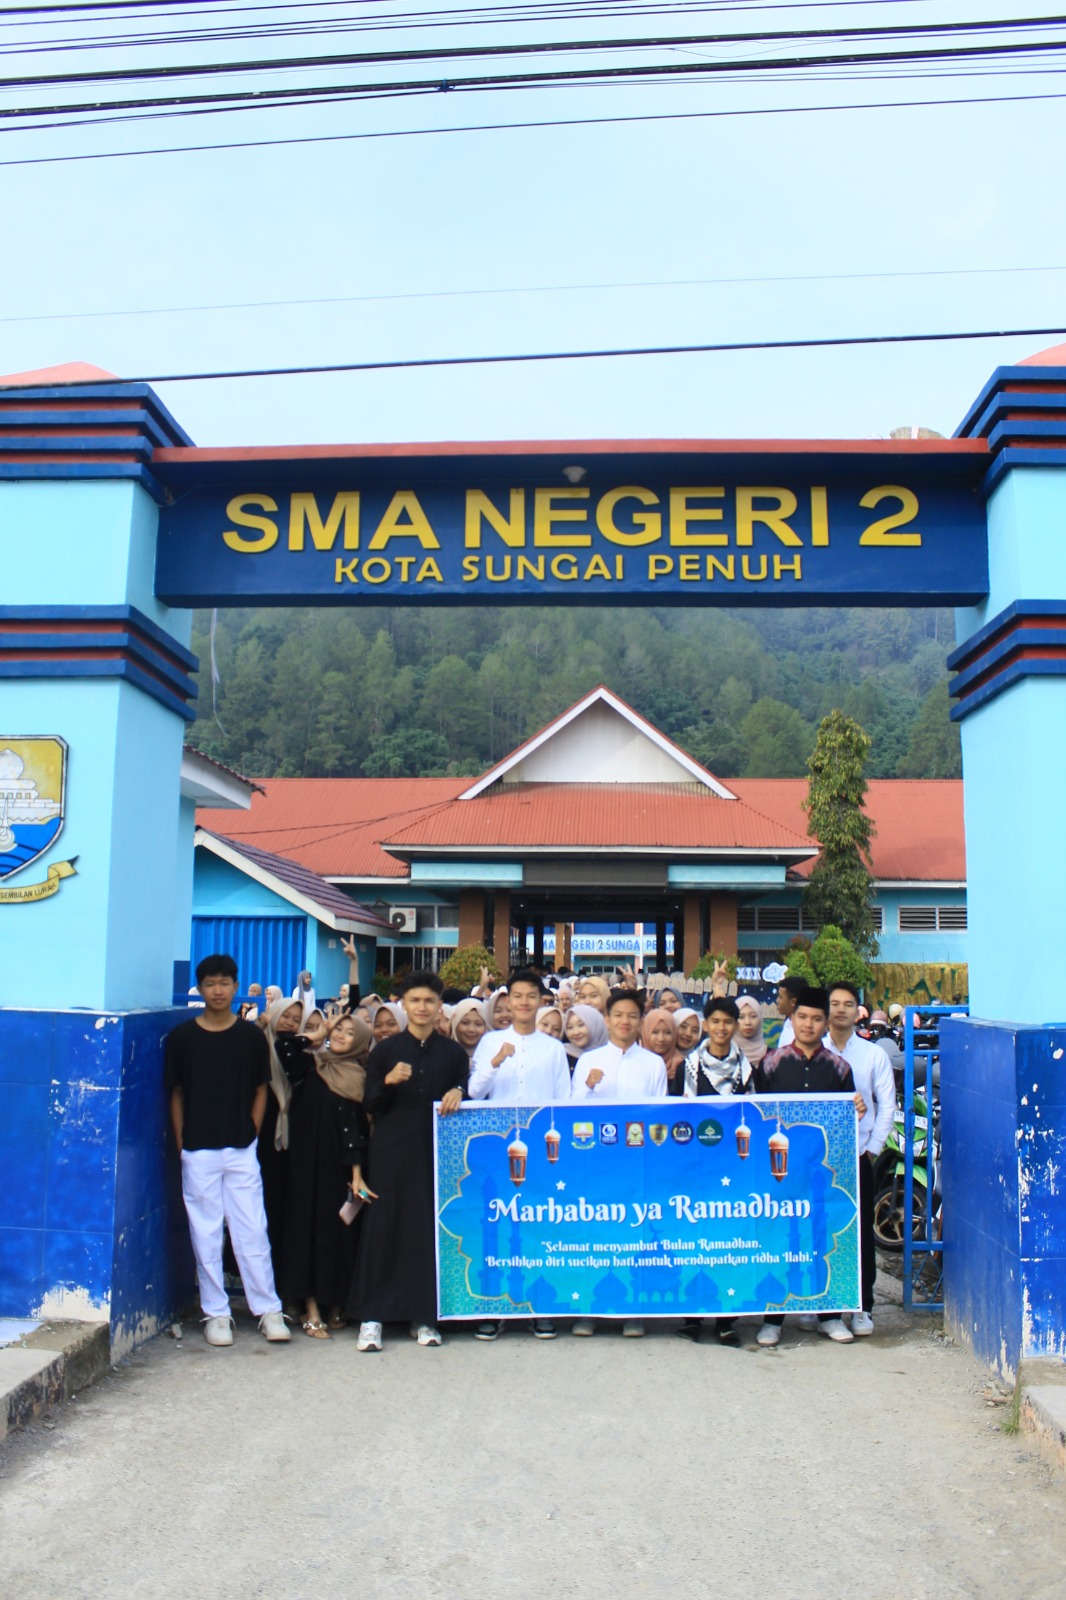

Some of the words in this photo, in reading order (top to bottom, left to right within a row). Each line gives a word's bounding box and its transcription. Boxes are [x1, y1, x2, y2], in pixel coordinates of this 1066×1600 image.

[222, 490, 441, 553] SMA
[464, 485, 829, 548] NEGERI
[858, 484, 922, 546] 2
[334, 557, 443, 583] KOTA
[462, 554, 624, 581] SUNGAI
[648, 554, 802, 580] PENUH
[572, 940, 595, 950] GERI
[598, 940, 604, 950] 2
[606, 940, 641, 950] SUNGA
[487, 1193, 627, 1224] Marhaban
[630, 1202, 663, 1227] ya
[668, 1193, 811, 1224] Ramadhan
[592, 1239, 658, 1254] menyambut
[660, 1238, 696, 1251] Bulan
[697, 1237, 762, 1251] Ramadhan.
[485, 1255, 543, 1269] Bersihkan
[545, 1256, 565, 1267] diri
[567, 1255, 610, 1269] sucikan
[673, 1252, 749, 1267] mendapatkan
[751, 1251, 780, 1264] ridha
